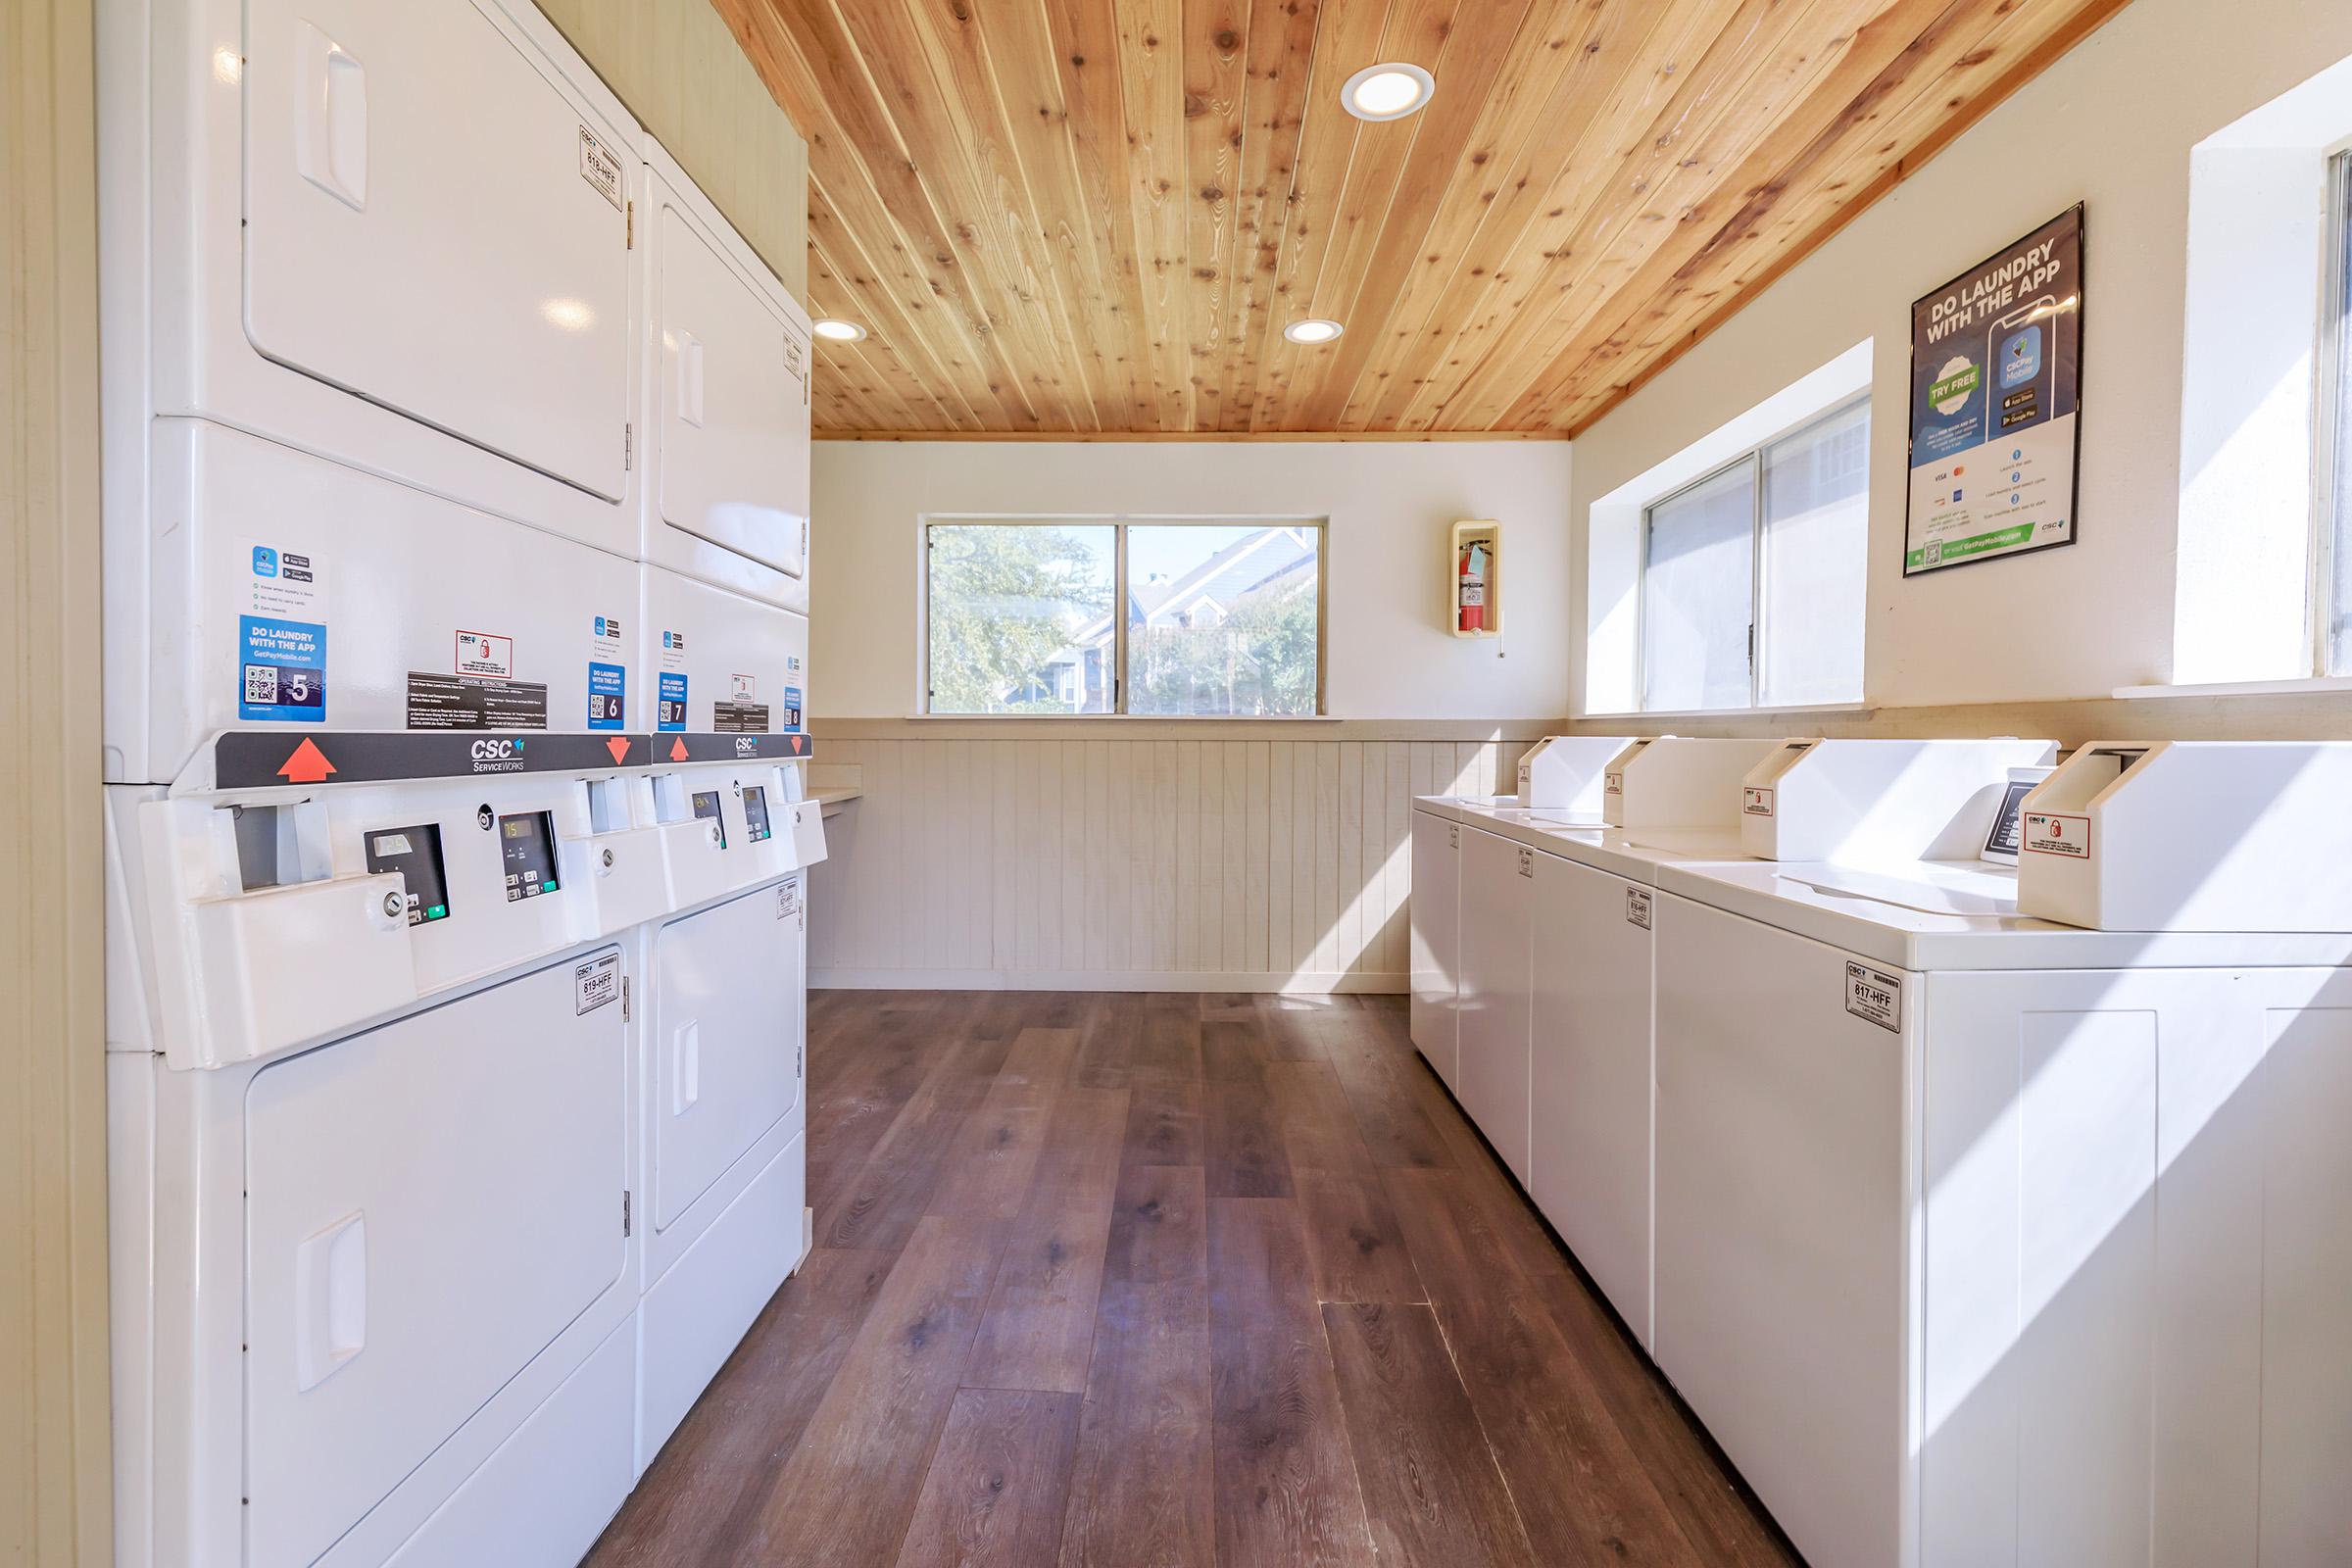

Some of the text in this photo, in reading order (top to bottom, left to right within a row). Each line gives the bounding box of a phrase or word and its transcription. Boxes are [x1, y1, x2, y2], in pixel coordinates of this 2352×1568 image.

[1932, 238, 2054, 322] DO LAUNDRY
[1928, 260, 2060, 344] WITH THE APP
[1932, 371, 1977, 399] TRY FREE
[1935, 473, 1947, 482] VISA
[2041, 521, 2058, 531] CSC
[252, 626, 314, 643] DO LAUNDRY
[249, 636, 316, 653] WITH THE APP
[253, 650, 312, 662] GetPayMobile.com
[291, 673, 309, 702] 5
[609, 699, 617, 716] 6
[675, 704, 683, 721] 7
[792, 710, 799, 724] 8
[471, 740, 513, 760] CSC
[736, 737, 753, 751] CSC
[584, 973, 612, 994] 819-HFF
[1854, 984, 1891, 1006] 817-HFF
